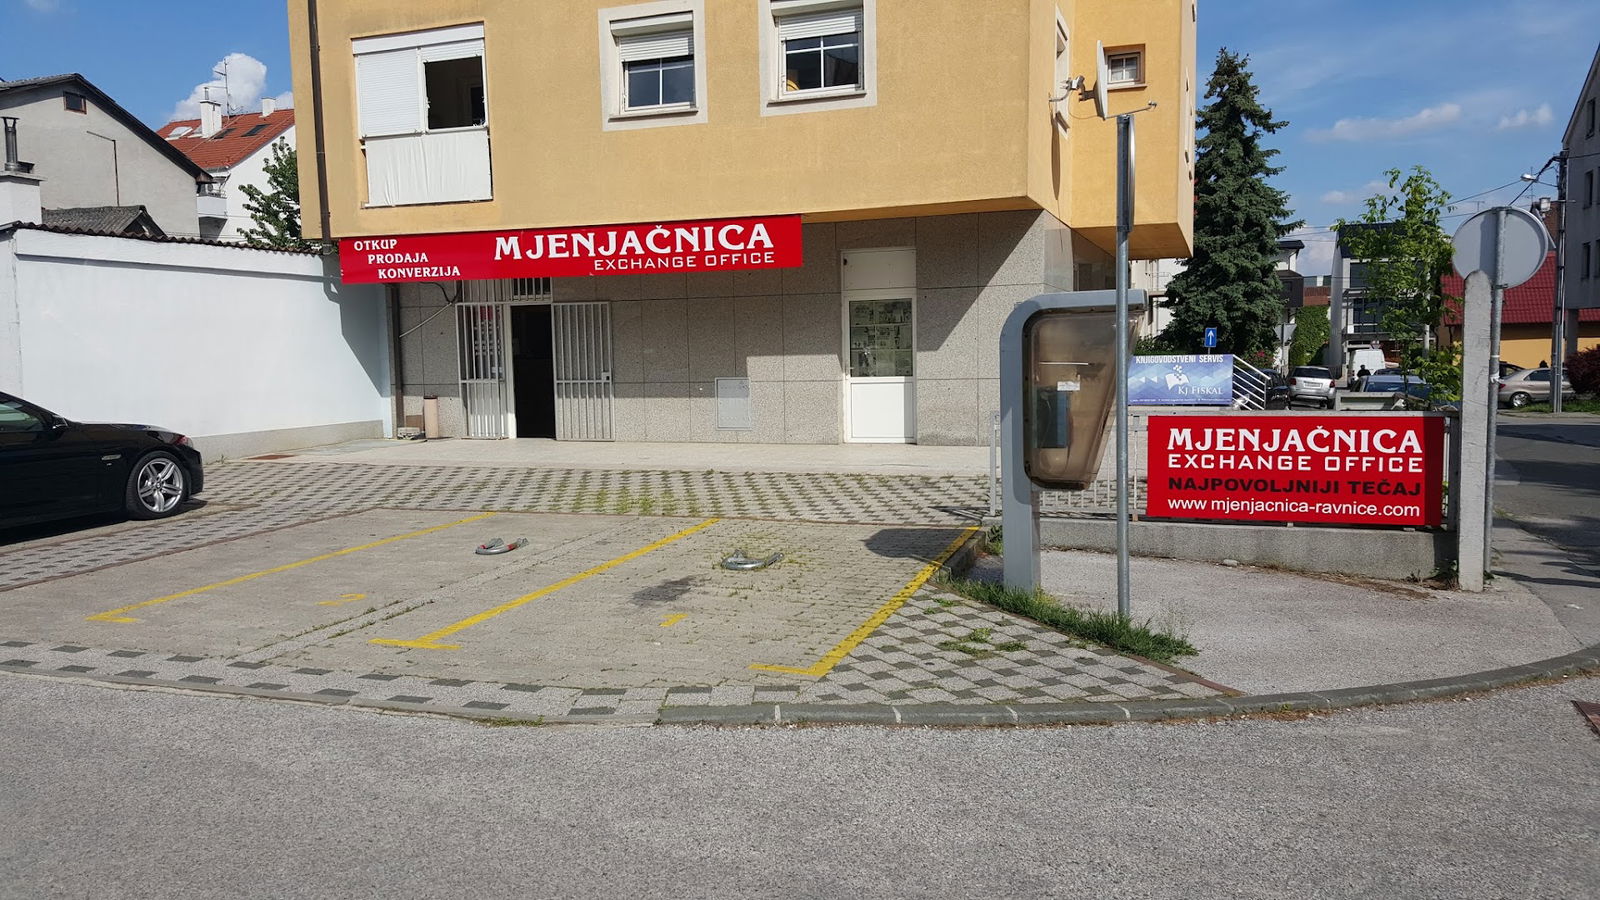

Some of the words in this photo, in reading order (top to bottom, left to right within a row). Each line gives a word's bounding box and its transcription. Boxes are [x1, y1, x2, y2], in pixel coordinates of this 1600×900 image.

[353, 238, 398, 251] OTKUP
[494, 223, 774, 261] MJENJAČNICA
[367, 252, 429, 264] PRODAJA
[594, 255, 697, 272] EXCHANGE
[704, 251, 775, 267] OFFICE
[377, 266, 461, 279] KONVERZIJA
[1135, 354, 1196, 364] KNJIGOVODSTVENI
[1199, 354, 1224, 363] SERVIS
[1167, 425, 1423, 454] MJENJAČNICA
[1168, 453, 1312, 471] EXCHANGE
[1324, 456, 1423, 474] OFFICE
[1168, 477, 1339, 495] NAJPOVOLJNIJI
[1346, 477, 1421, 497] TEČAJ
